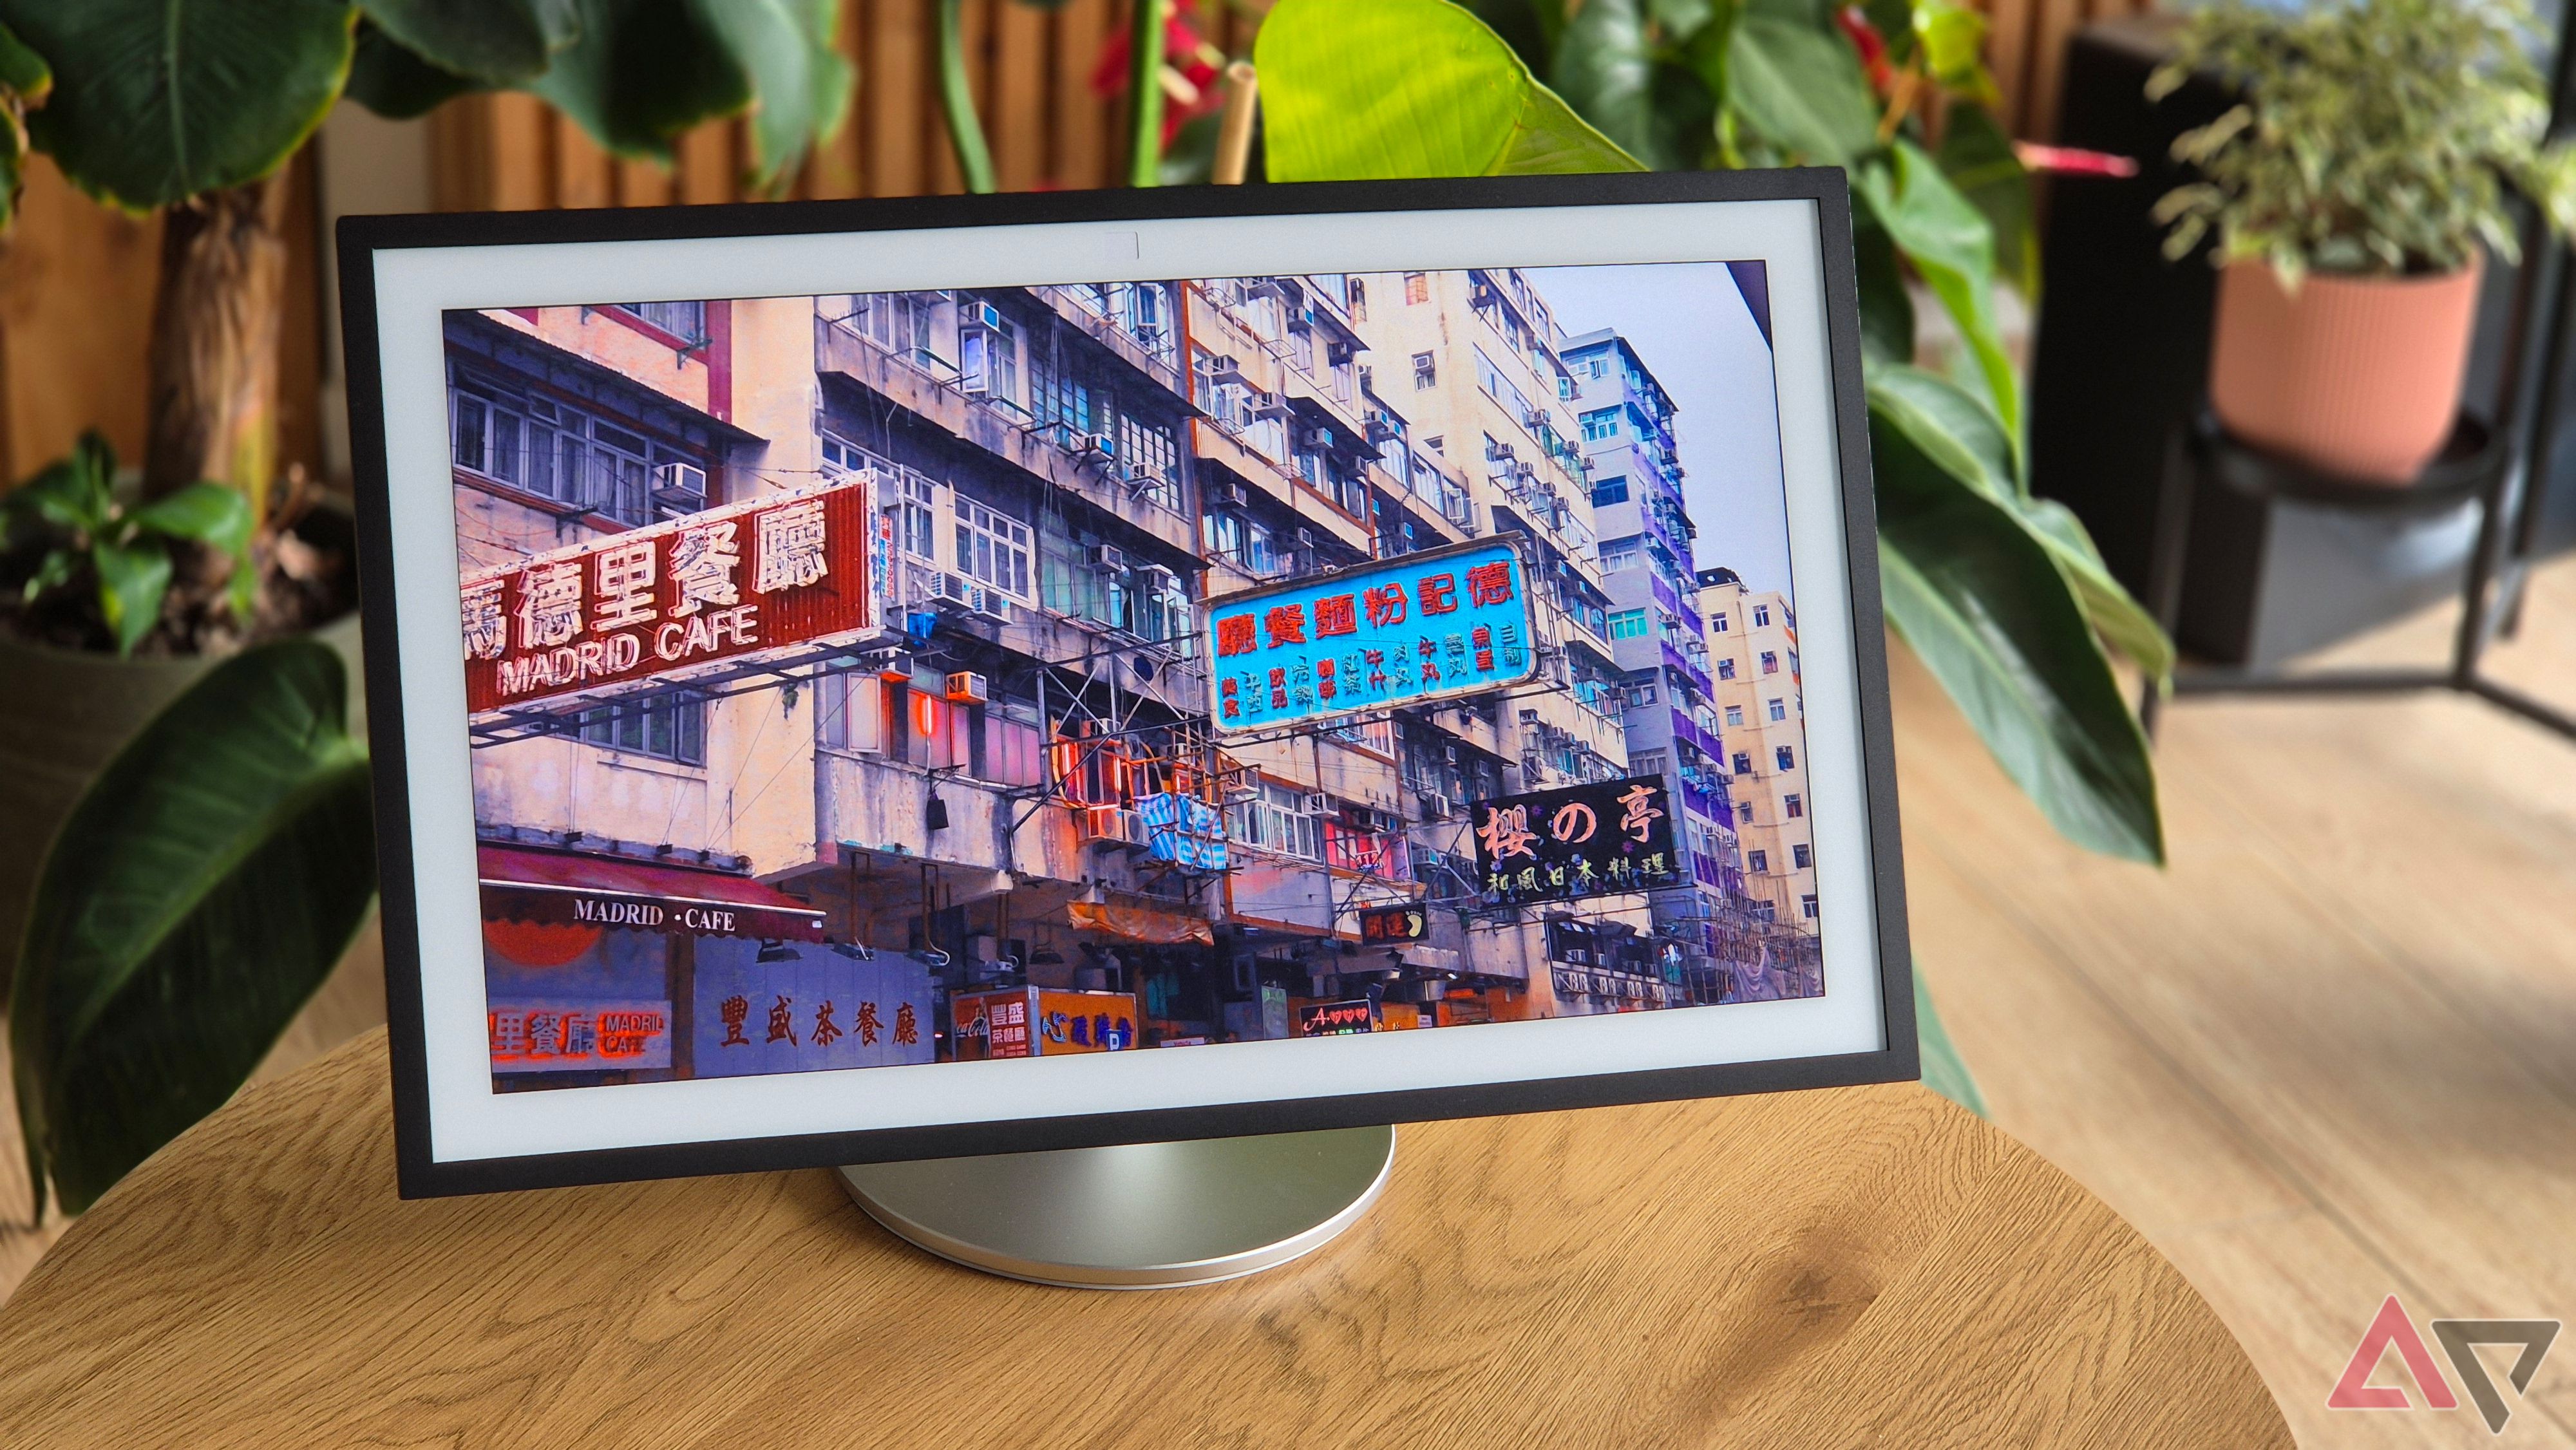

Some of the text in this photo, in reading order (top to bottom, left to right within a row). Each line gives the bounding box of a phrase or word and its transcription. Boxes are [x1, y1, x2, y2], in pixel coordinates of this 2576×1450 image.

[497, 605, 759, 697] MADRID CAFE
[574, 899, 735, 932] MADRID CAFE
